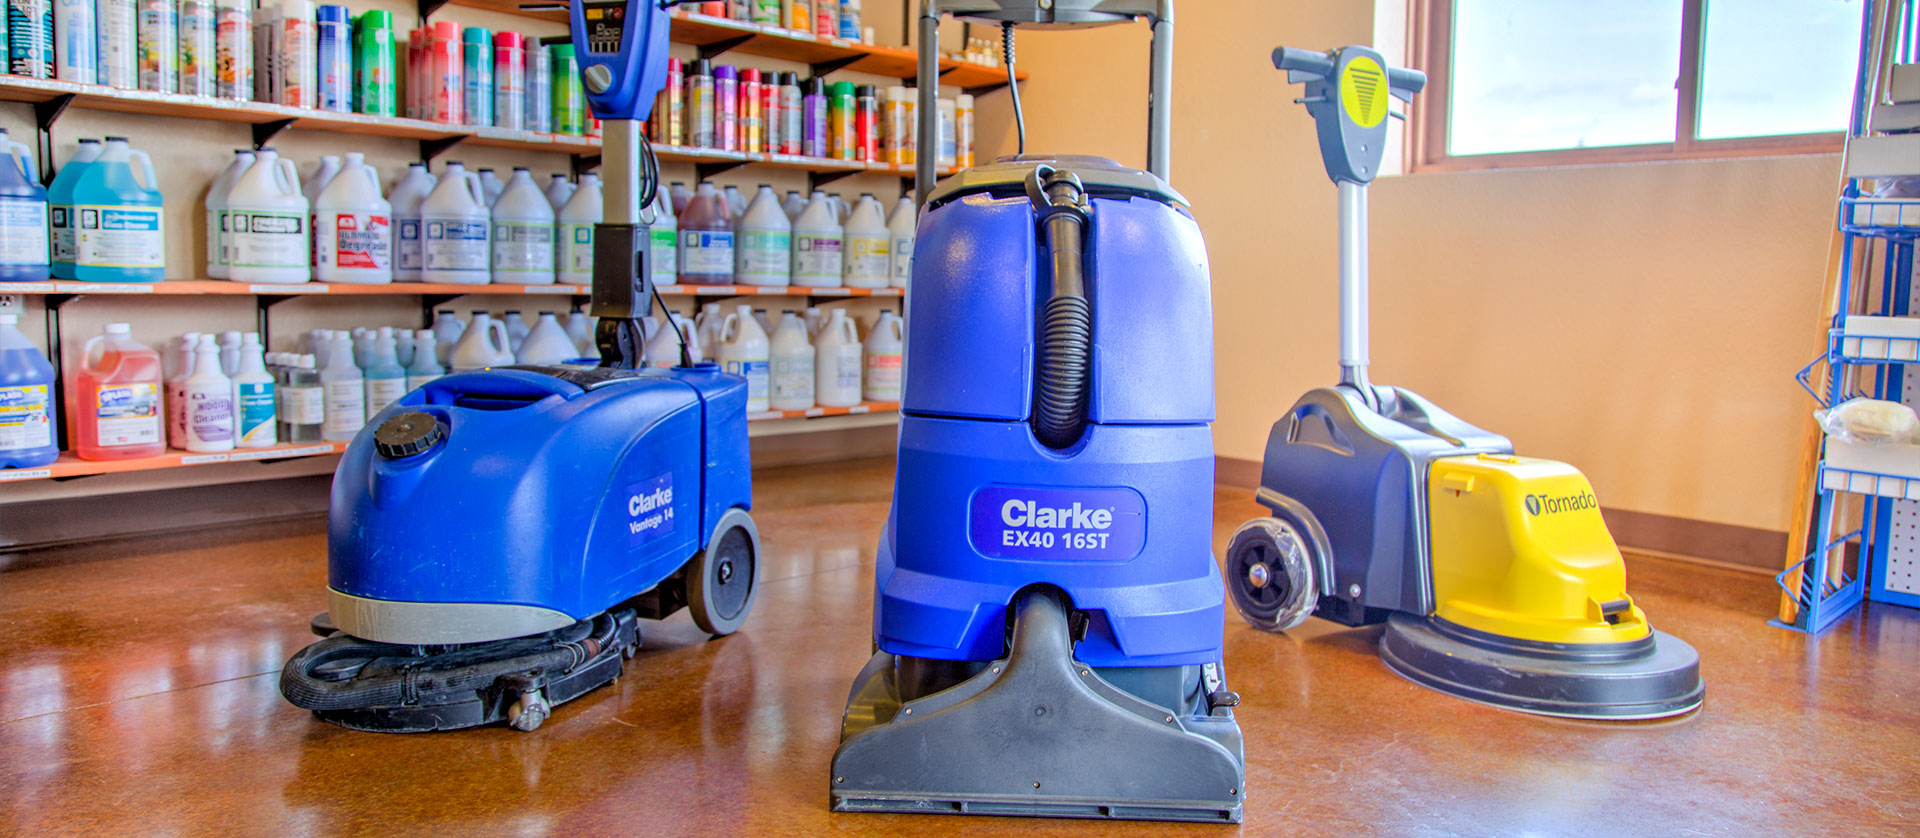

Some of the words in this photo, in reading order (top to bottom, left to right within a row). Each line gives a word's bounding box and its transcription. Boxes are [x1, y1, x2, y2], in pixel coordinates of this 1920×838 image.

[0, 391, 22, 400] PLASH
[628, 487, 673, 517] Clarke
[1001, 499, 1113, 529] Clarke
[1539, 489, 1597, 514] Tornado
[629, 514, 663, 534] Vantage
[664, 506, 674, 521] 14
[1002, 530, 1055, 549] EX40
[1061, 532, 1110, 549] 16ST
